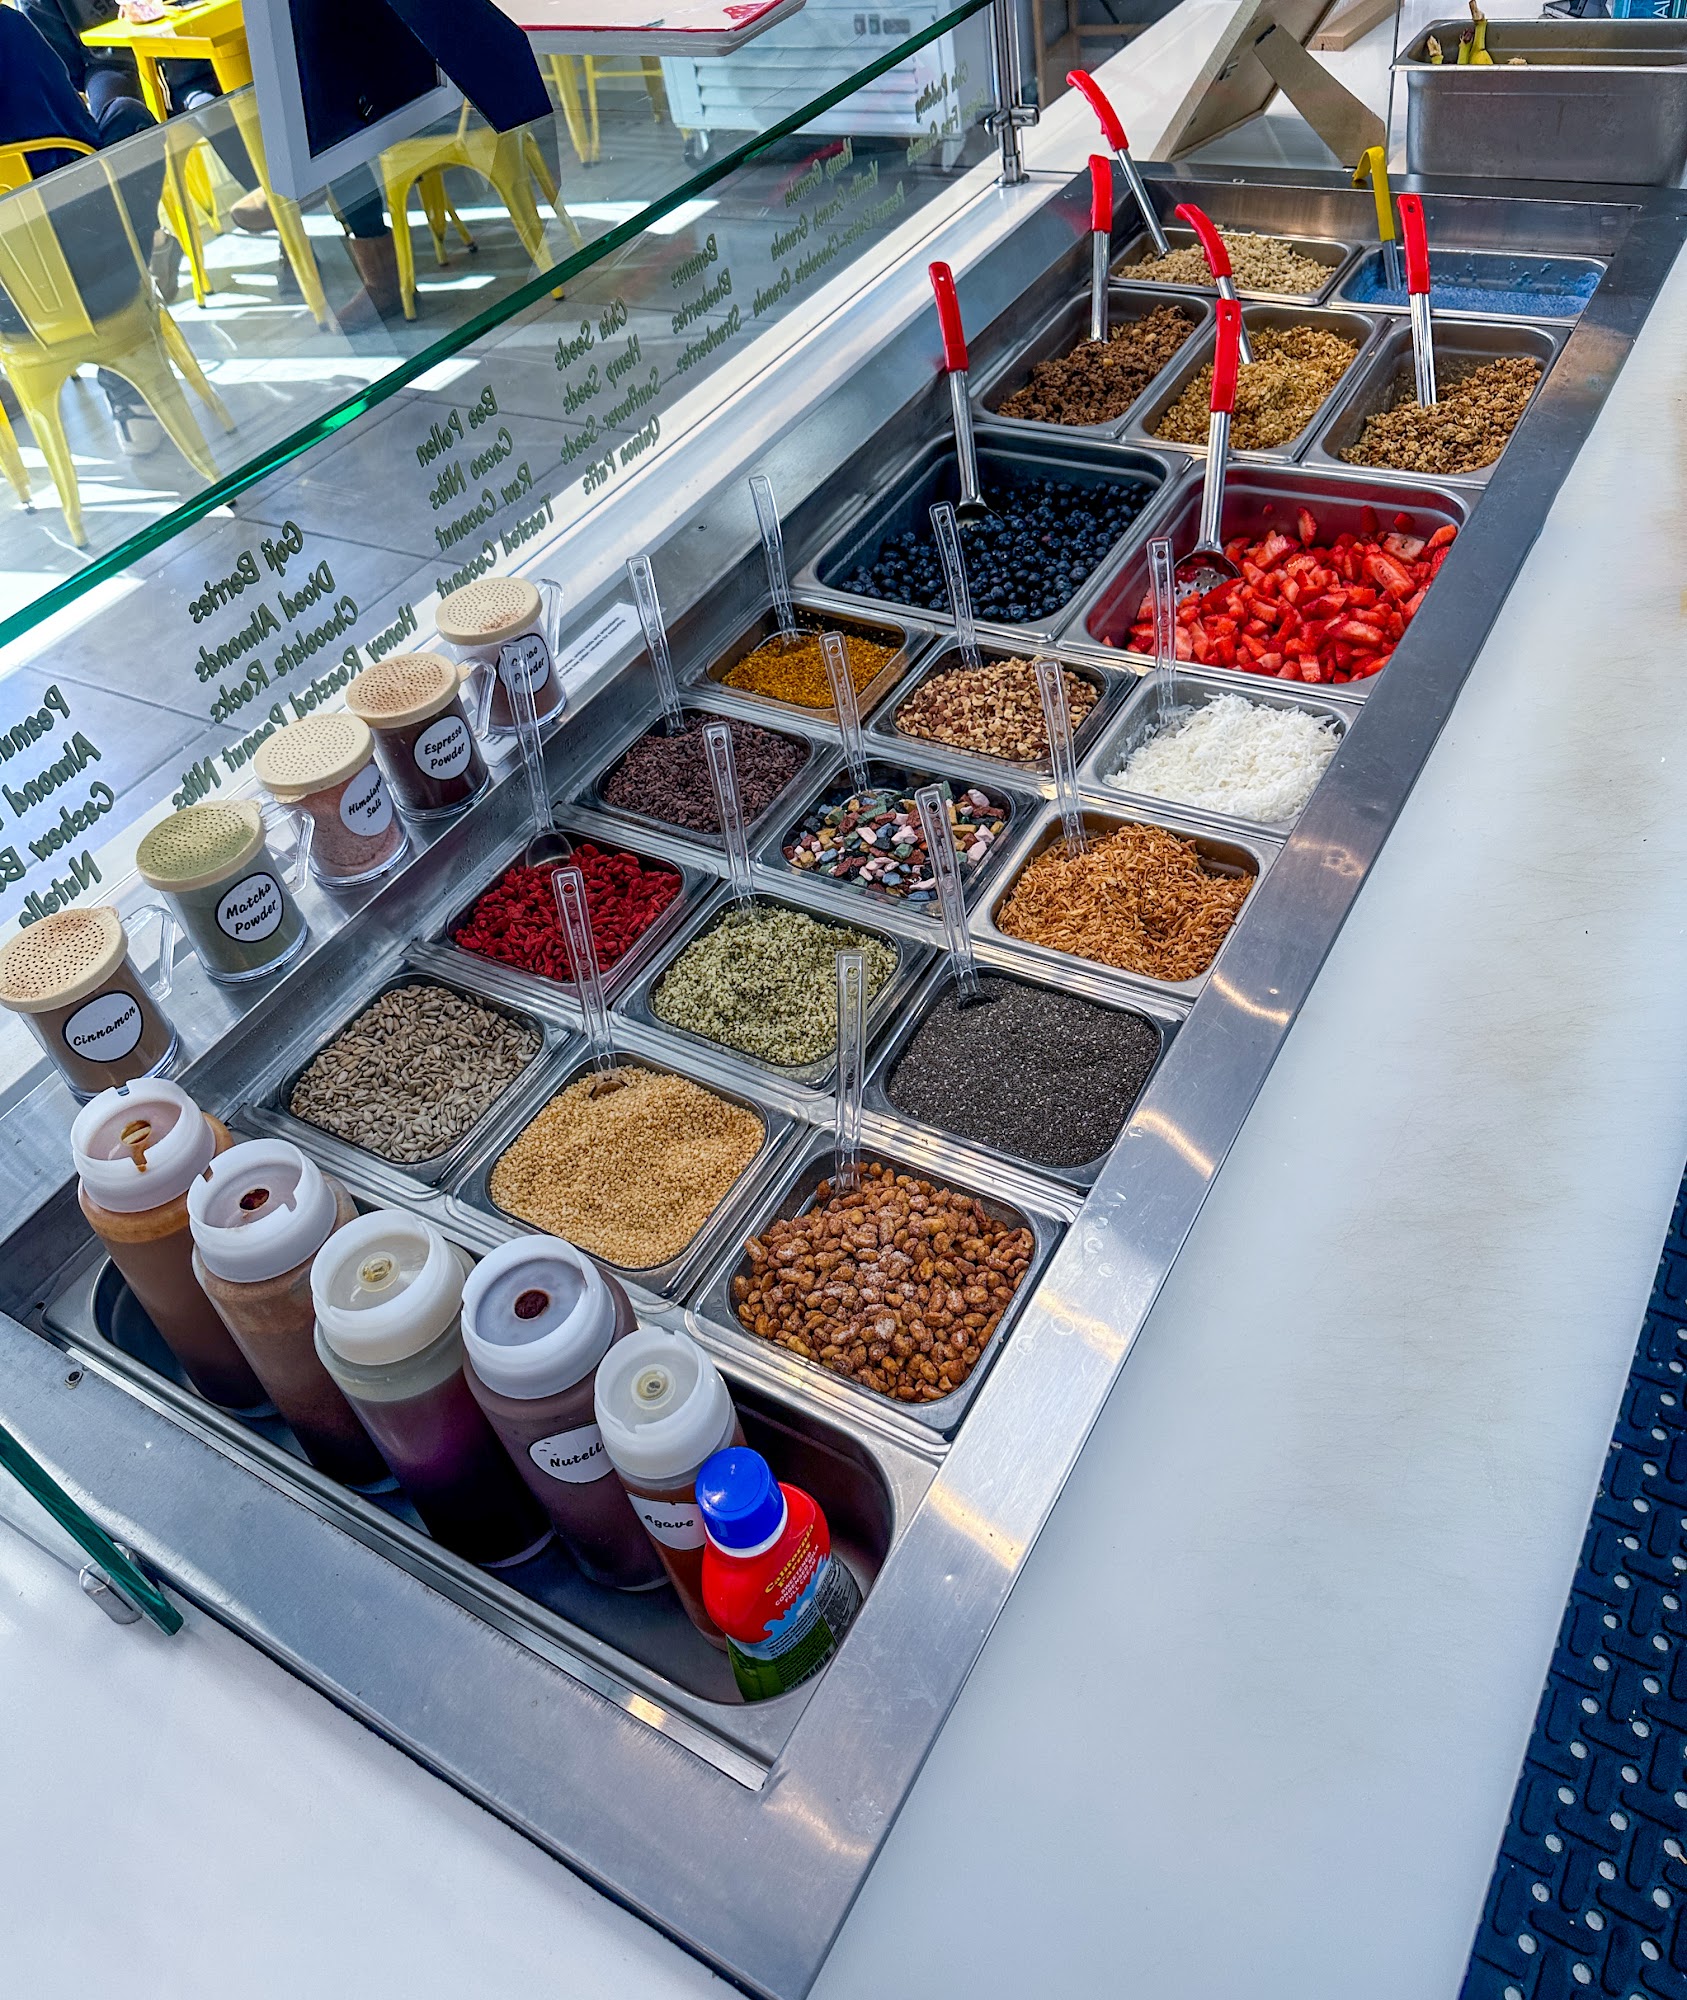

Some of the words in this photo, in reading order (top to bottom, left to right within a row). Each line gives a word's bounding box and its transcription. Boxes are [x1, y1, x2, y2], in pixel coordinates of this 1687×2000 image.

[424, 725, 462, 755] Espresso
[430, 742, 465, 769] Powder
[367, 798, 382, 818] Salt
[226, 882, 271, 920] Matcha
[235, 899, 278, 934] Powder
[73, 1005, 136, 1046] Cinnamon
[550, 1442, 605, 1467] Nutell
[765, 1524, 814, 1593] California
[778, 1542, 811, 1588] Farms
[781, 1551, 811, 1595] SWEETENED
[775, 1565, 808, 1606] CONDENSED
[785, 1586, 799, 1603] FULL
[800, 1557, 816, 1585] CREAM
